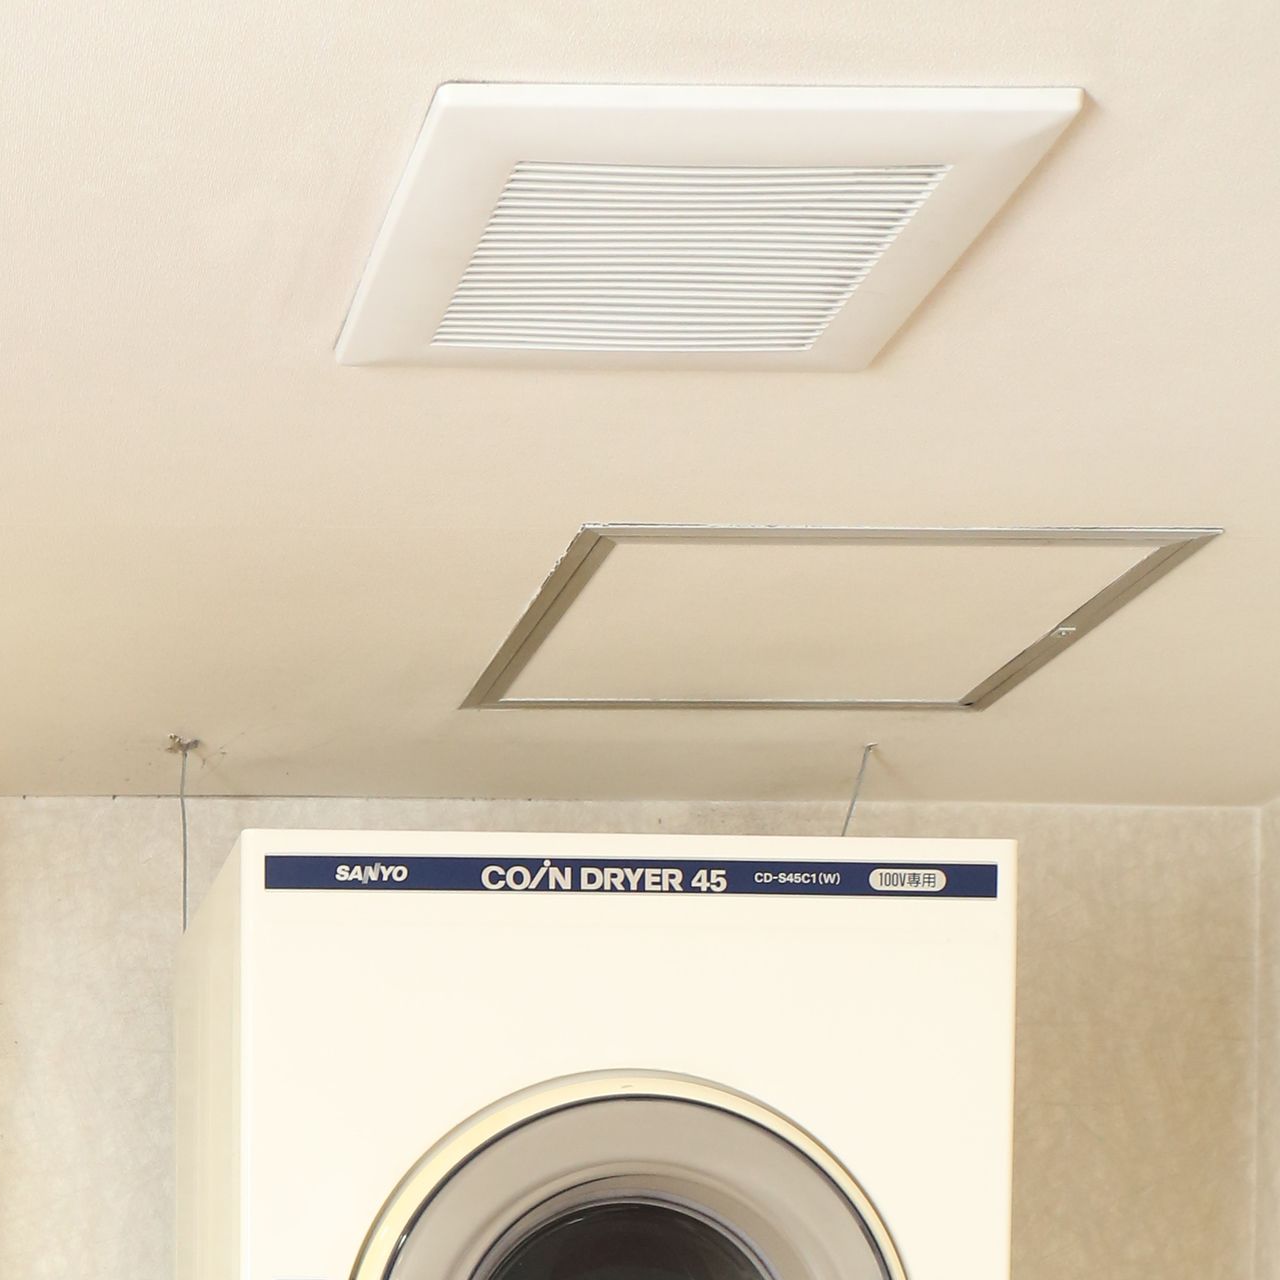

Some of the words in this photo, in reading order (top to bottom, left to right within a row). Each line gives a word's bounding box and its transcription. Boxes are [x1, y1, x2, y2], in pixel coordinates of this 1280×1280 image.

[335, 862, 408, 885] SANYO
[580, 866, 684, 891] DRYER
[691, 869, 727, 892] 45
[754, 872, 841, 886] CD-S45C1(W)
[879, 872, 937, 888] 100V専用
